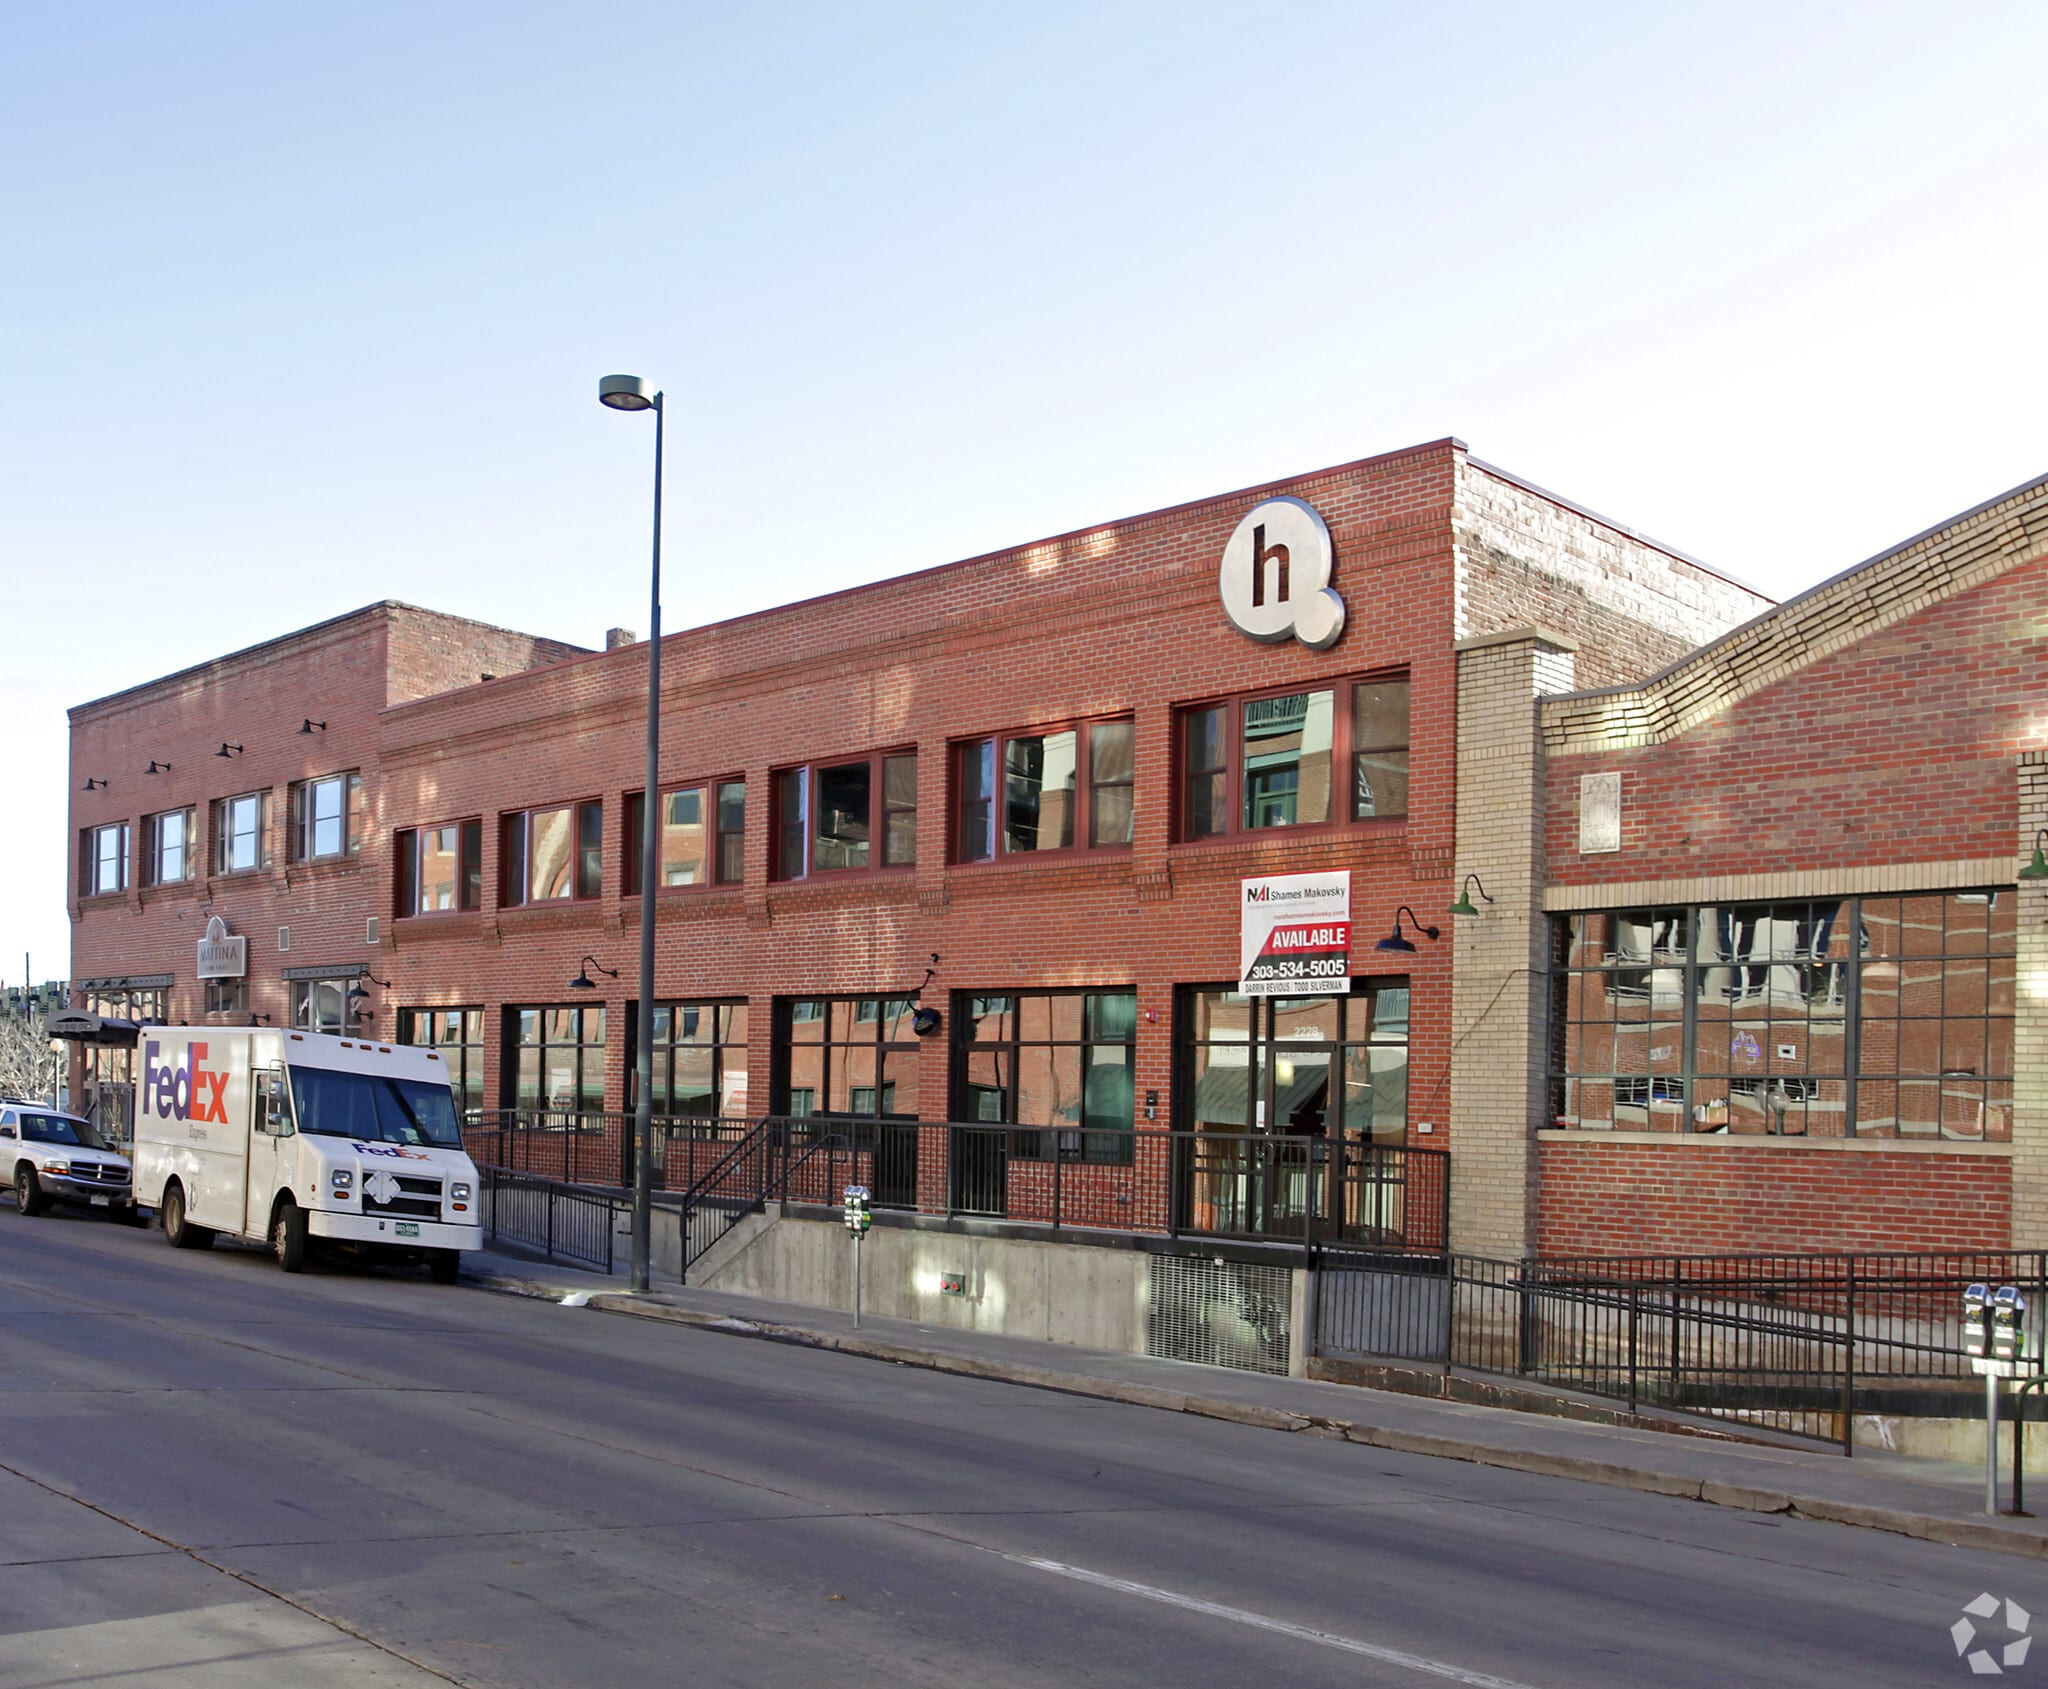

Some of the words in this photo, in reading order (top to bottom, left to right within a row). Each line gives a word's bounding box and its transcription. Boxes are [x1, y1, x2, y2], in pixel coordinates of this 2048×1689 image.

[1253, 522, 1290, 608] h
[1247, 884, 1270, 902] NAI
[1271, 889, 1302, 901] Shames
[1304, 886, 1345, 898] Makovsky
[1272, 928, 1346, 948] AVAILABLE
[1252, 959, 1346, 979] 303-534-5005
[1245, 983, 1265, 993] DARRIN
[1266, 982, 1290, 993] REVIOUS
[1294, 981, 1309, 992] TODD
[1310, 980, 1342, 991] SILVERMAN
[1294, 1026, 1319, 1037] 2228
[143, 1041, 230, 1124] FedEx
[351, 1143, 432, 1161] FedEx
